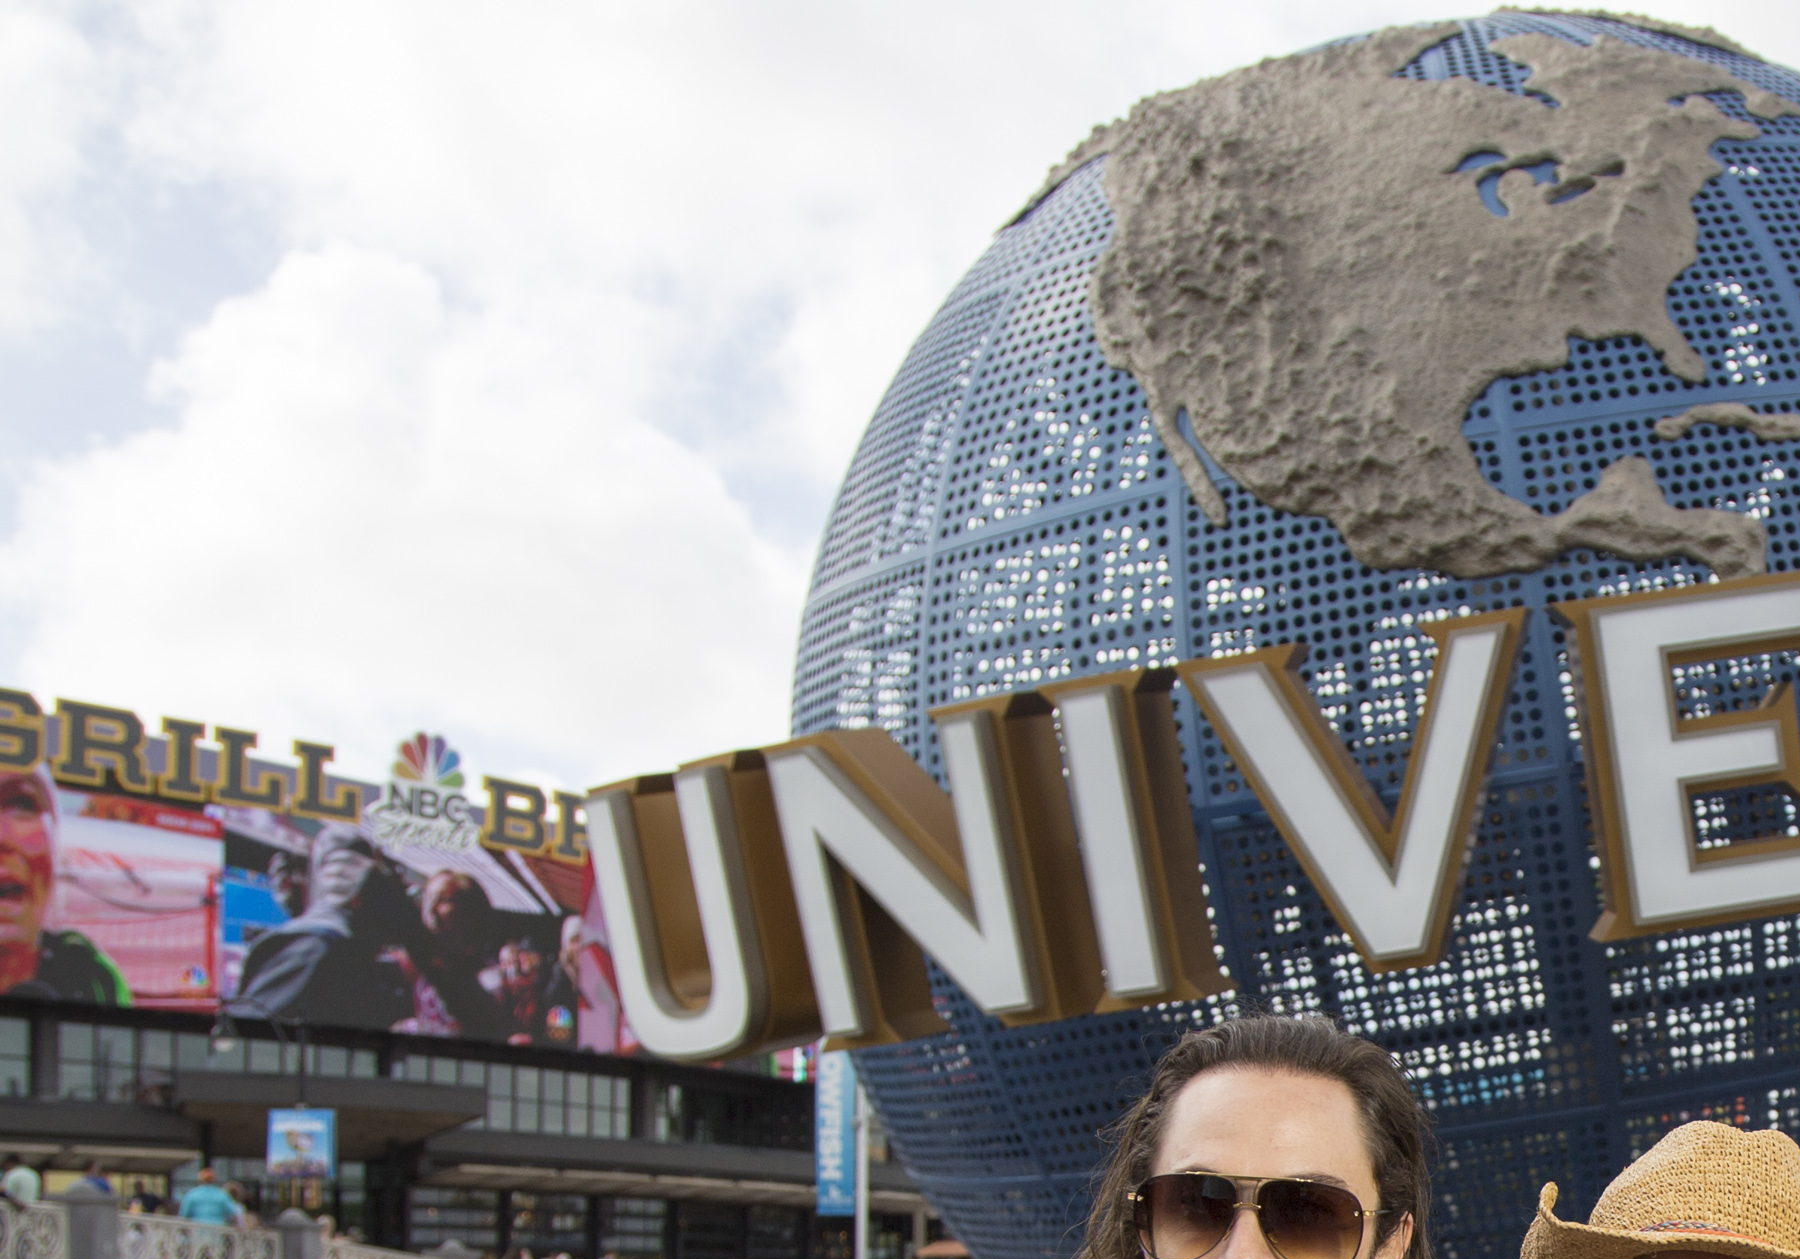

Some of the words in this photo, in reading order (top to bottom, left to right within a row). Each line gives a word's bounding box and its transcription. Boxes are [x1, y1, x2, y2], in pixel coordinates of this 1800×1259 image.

[390, 780, 470, 825] NBC
[371, 803, 478, 850] Sports
[819, 1054, 843, 1181] OWFISH
